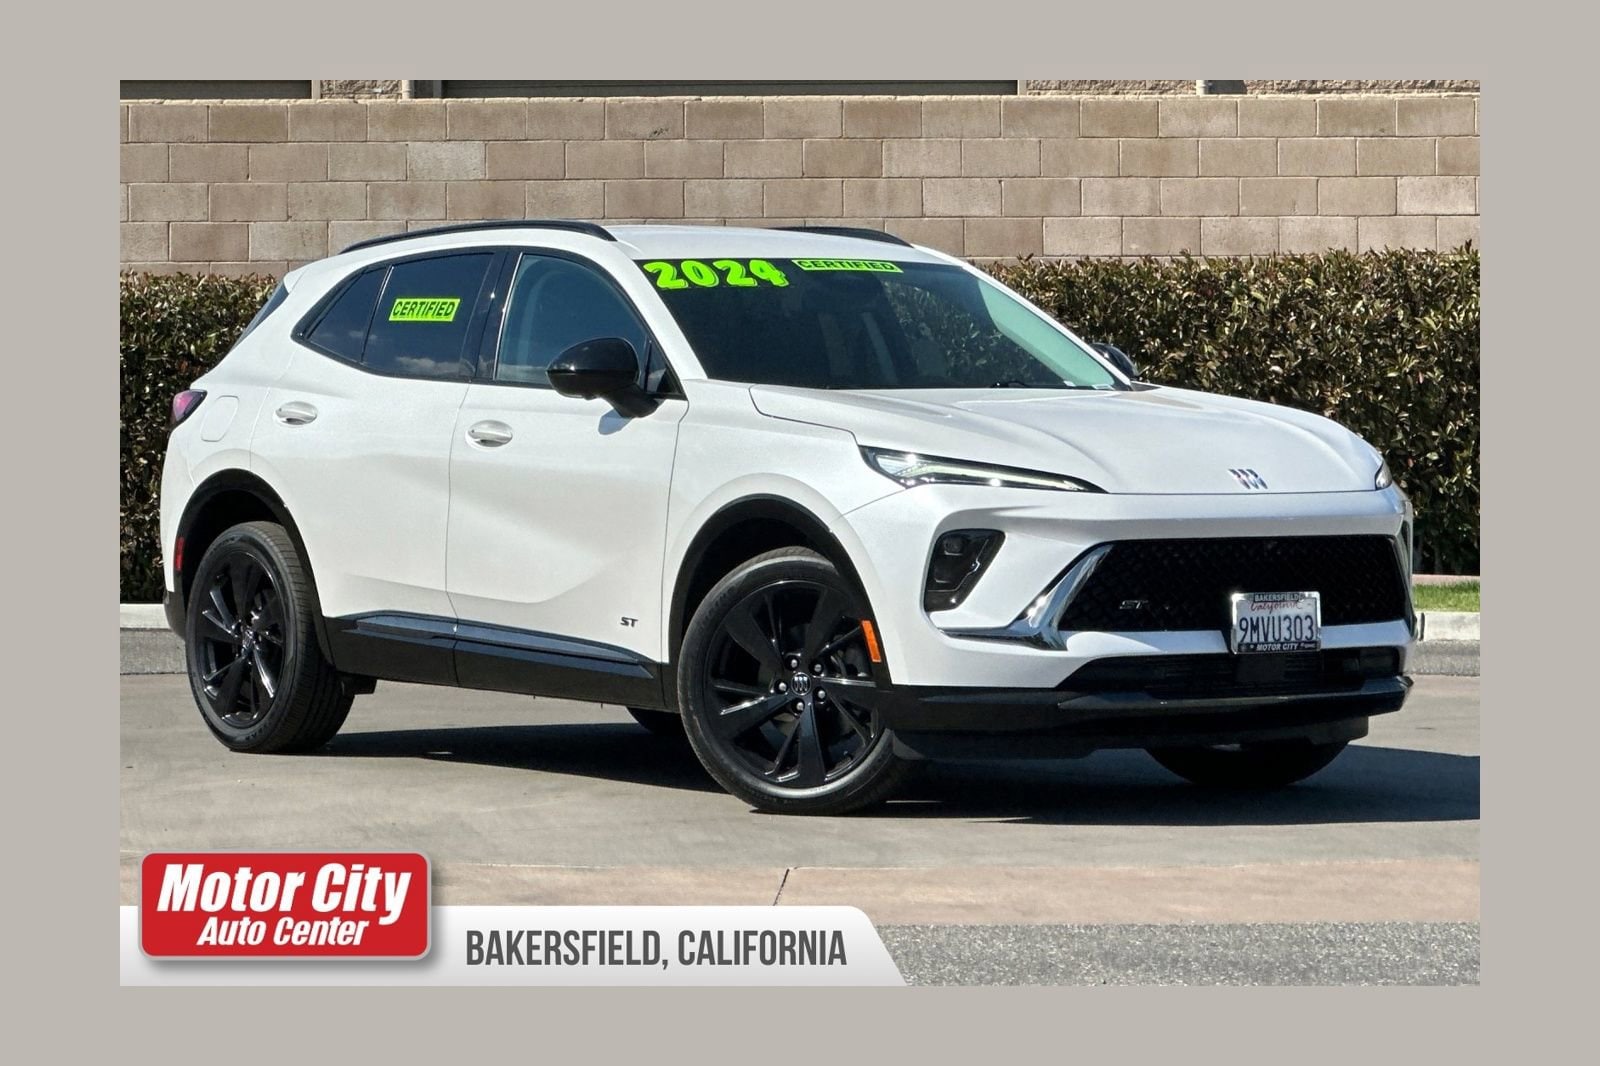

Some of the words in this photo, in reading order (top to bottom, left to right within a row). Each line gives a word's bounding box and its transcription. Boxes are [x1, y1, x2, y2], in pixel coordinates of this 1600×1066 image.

[798, 260, 896, 271] CERTIFIED
[643, 258, 789, 290] 2024
[393, 300, 456, 317] CERTIFIED
[1254, 593, 1299, 602] BAKERSFIELD
[620, 616, 639, 628] ST
[1239, 614, 1315, 643] 9MVU303
[1256, 642, 1281, 652] MOTOR
[1282, 642, 1299, 651] CITY
